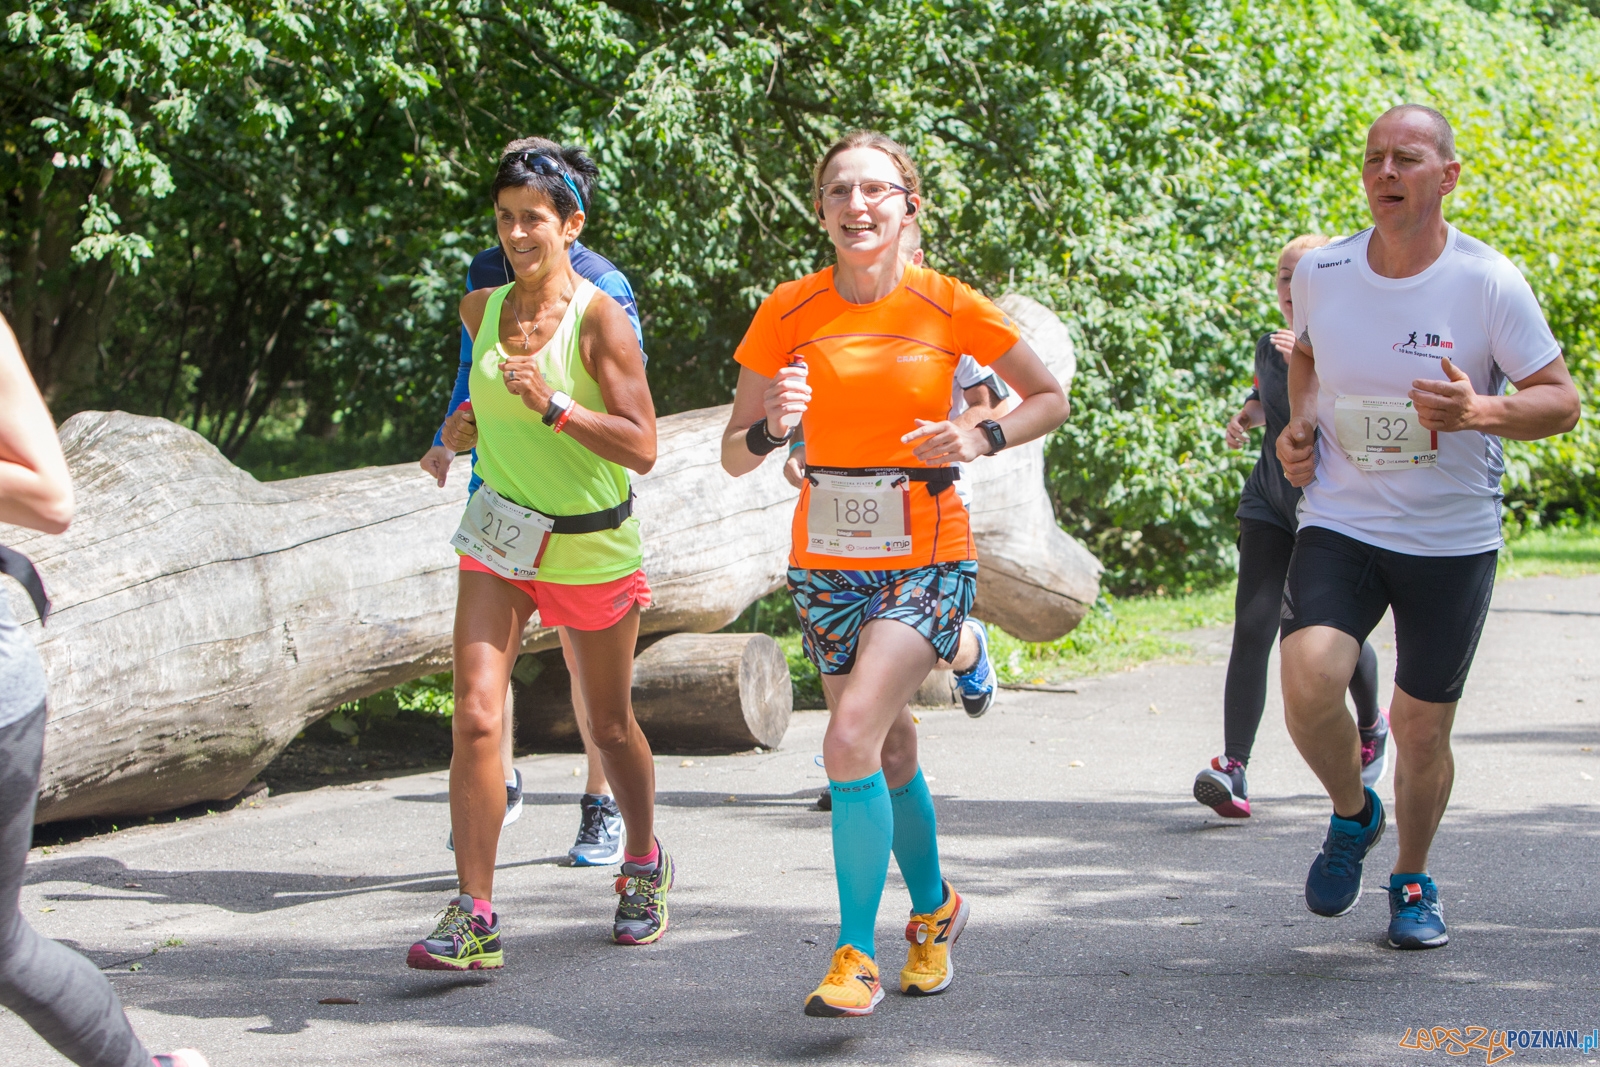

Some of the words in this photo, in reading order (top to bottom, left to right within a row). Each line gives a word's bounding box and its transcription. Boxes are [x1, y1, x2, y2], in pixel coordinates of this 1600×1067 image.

[1425, 333, 1440, 347] 10
[1364, 416, 1409, 441] 132
[834, 498, 879, 524] 188
[481, 511, 521, 549] 212
[892, 540, 910, 549] mjp
